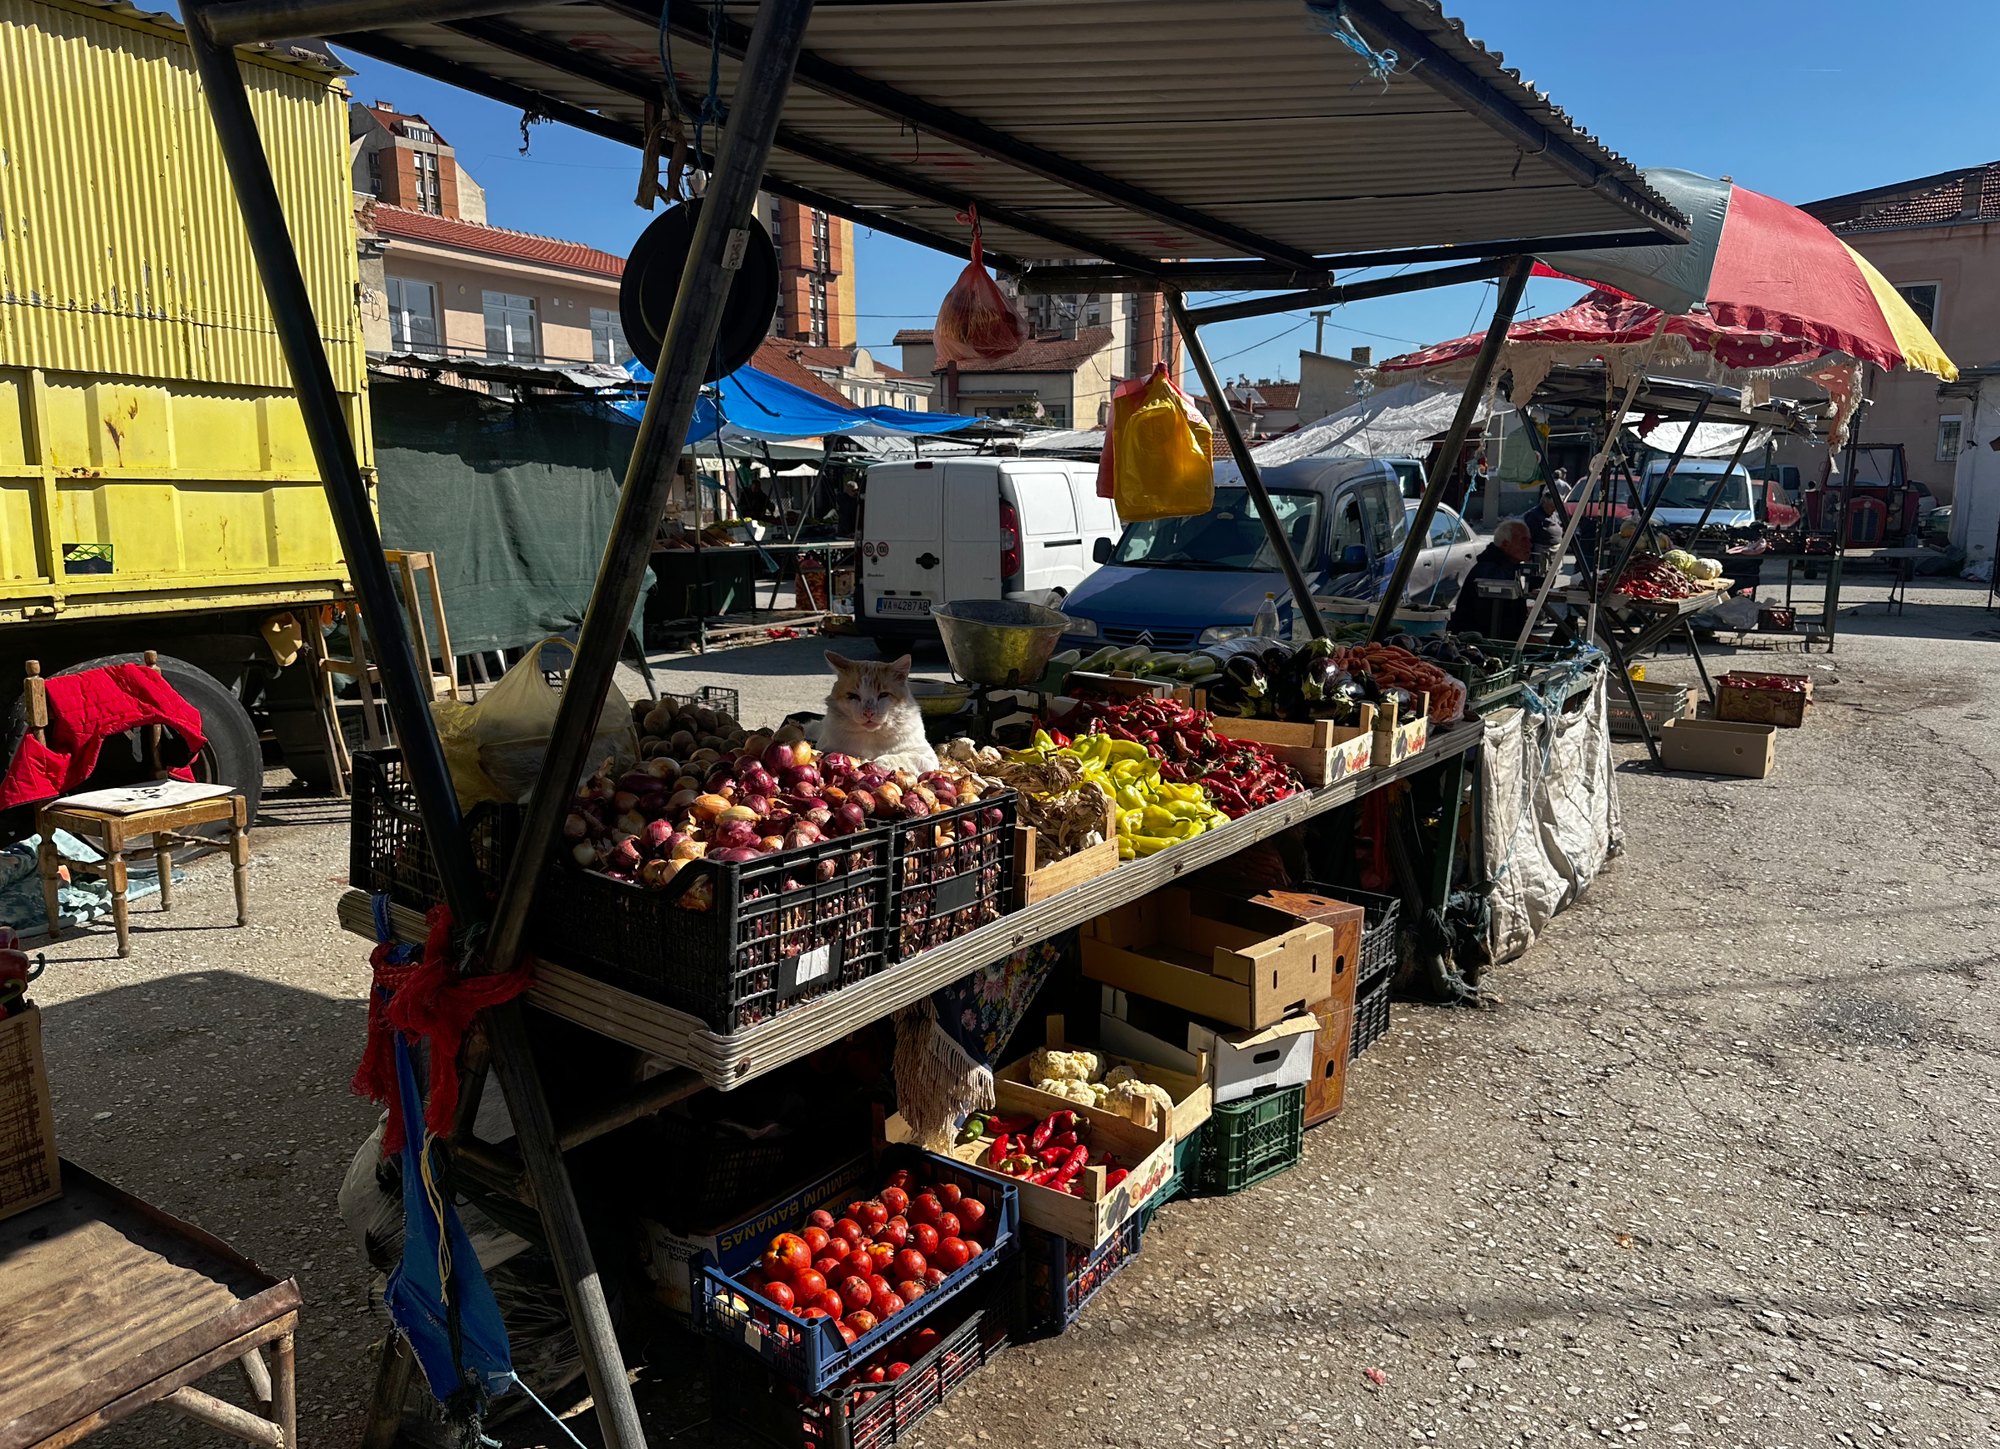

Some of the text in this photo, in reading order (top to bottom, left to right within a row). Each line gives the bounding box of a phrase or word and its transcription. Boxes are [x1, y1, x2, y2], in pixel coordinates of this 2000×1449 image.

[883, 600, 892, 609] VA
[898, 601, 918, 611] 4287
[720, 1163, 866, 1251] PREMIUM BANANAS
